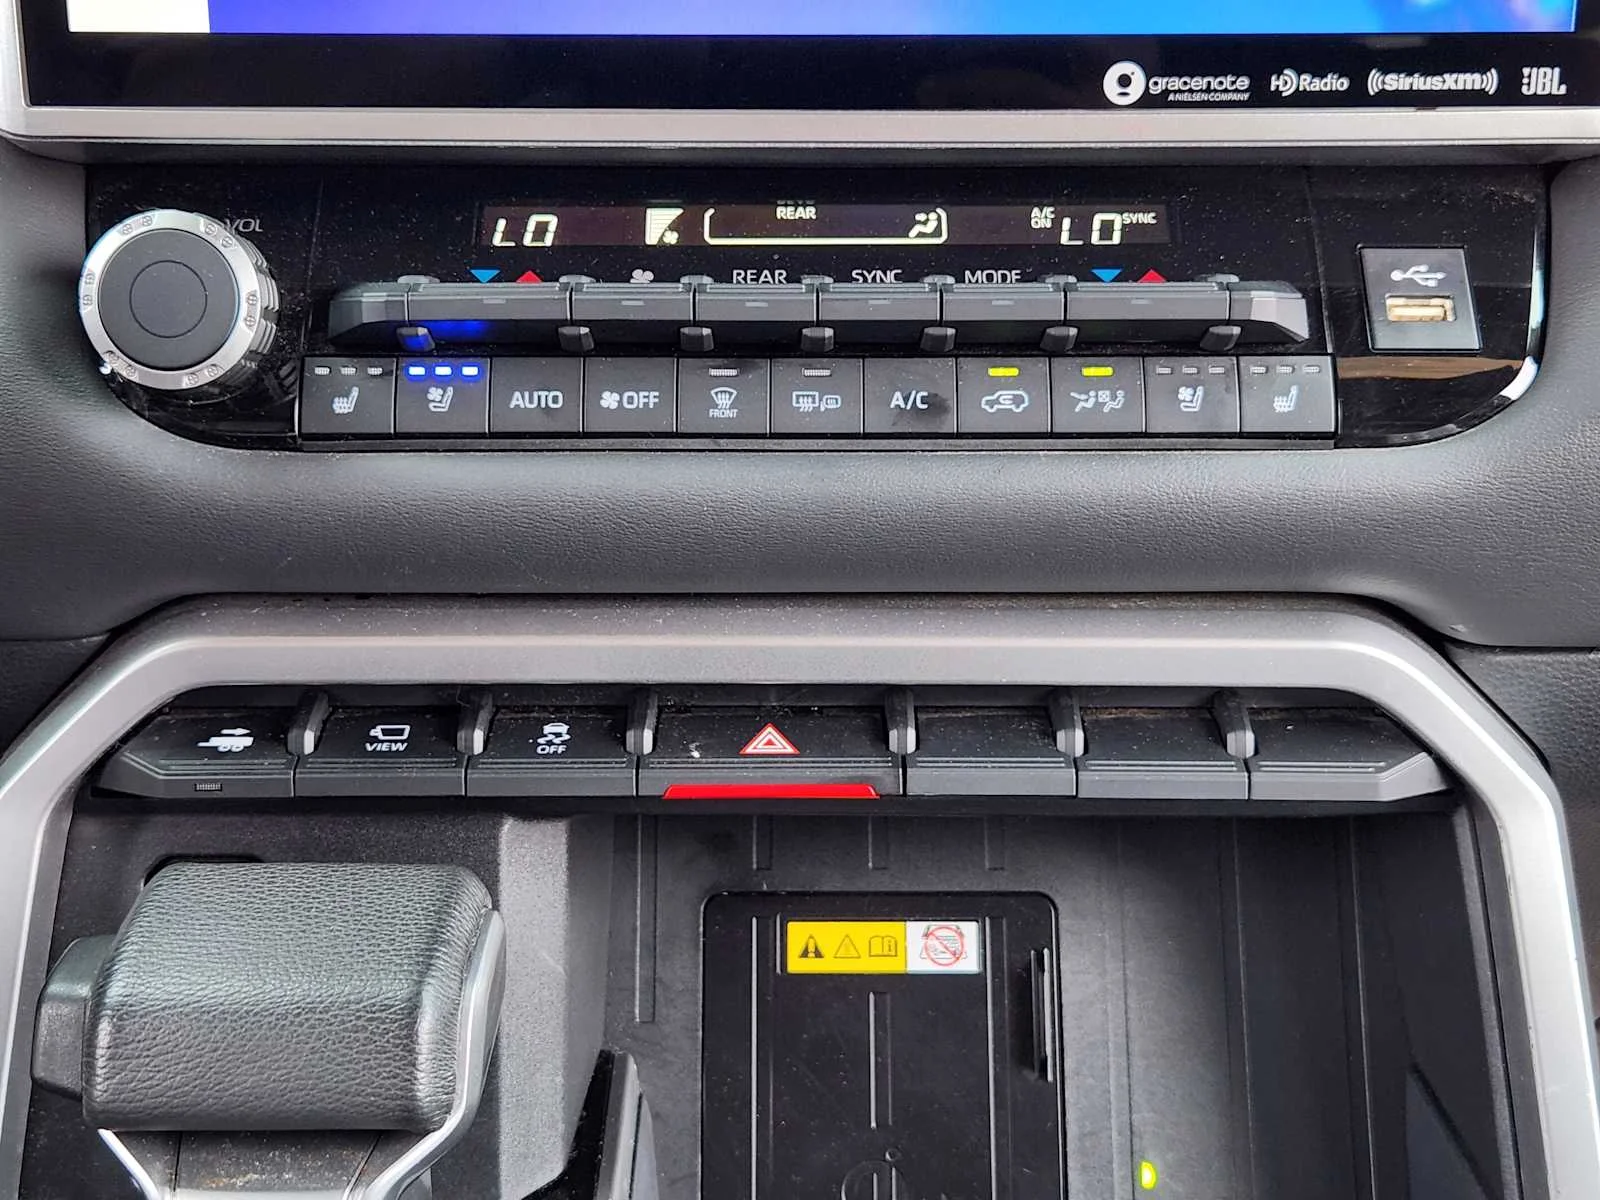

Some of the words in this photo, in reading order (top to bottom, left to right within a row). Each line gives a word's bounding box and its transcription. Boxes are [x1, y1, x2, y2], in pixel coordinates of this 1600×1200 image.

[1148, 74, 1251, 94] gracenote
[1299, 72, 1350, 91] Radio
[1521, 67, 1567, 95] JBL
[1175, 92, 1208, 101] NIELSEN
[1208, 92, 1251, 101] COMPANY
[775, 205, 817, 220] REAR
[1030, 206, 1056, 219] A/C
[1121, 212, 1158, 224] SYNC
[227, 217, 264, 234] VOL
[492, 213, 559, 247] LO
[1030, 218, 1053, 229] ON
[1060, 212, 1123, 246] LO
[732, 269, 787, 285] REAR
[851, 269, 903, 284] SYNC
[964, 269, 1022, 285] MODE
[509, 390, 564, 410] AUTO
[622, 390, 660, 410] OFF
[890, 389, 930, 411] A/C
[708, 407, 739, 420] FRONT
[365, 742, 408, 754] VIEW
[536, 743, 568, 756] OFF
